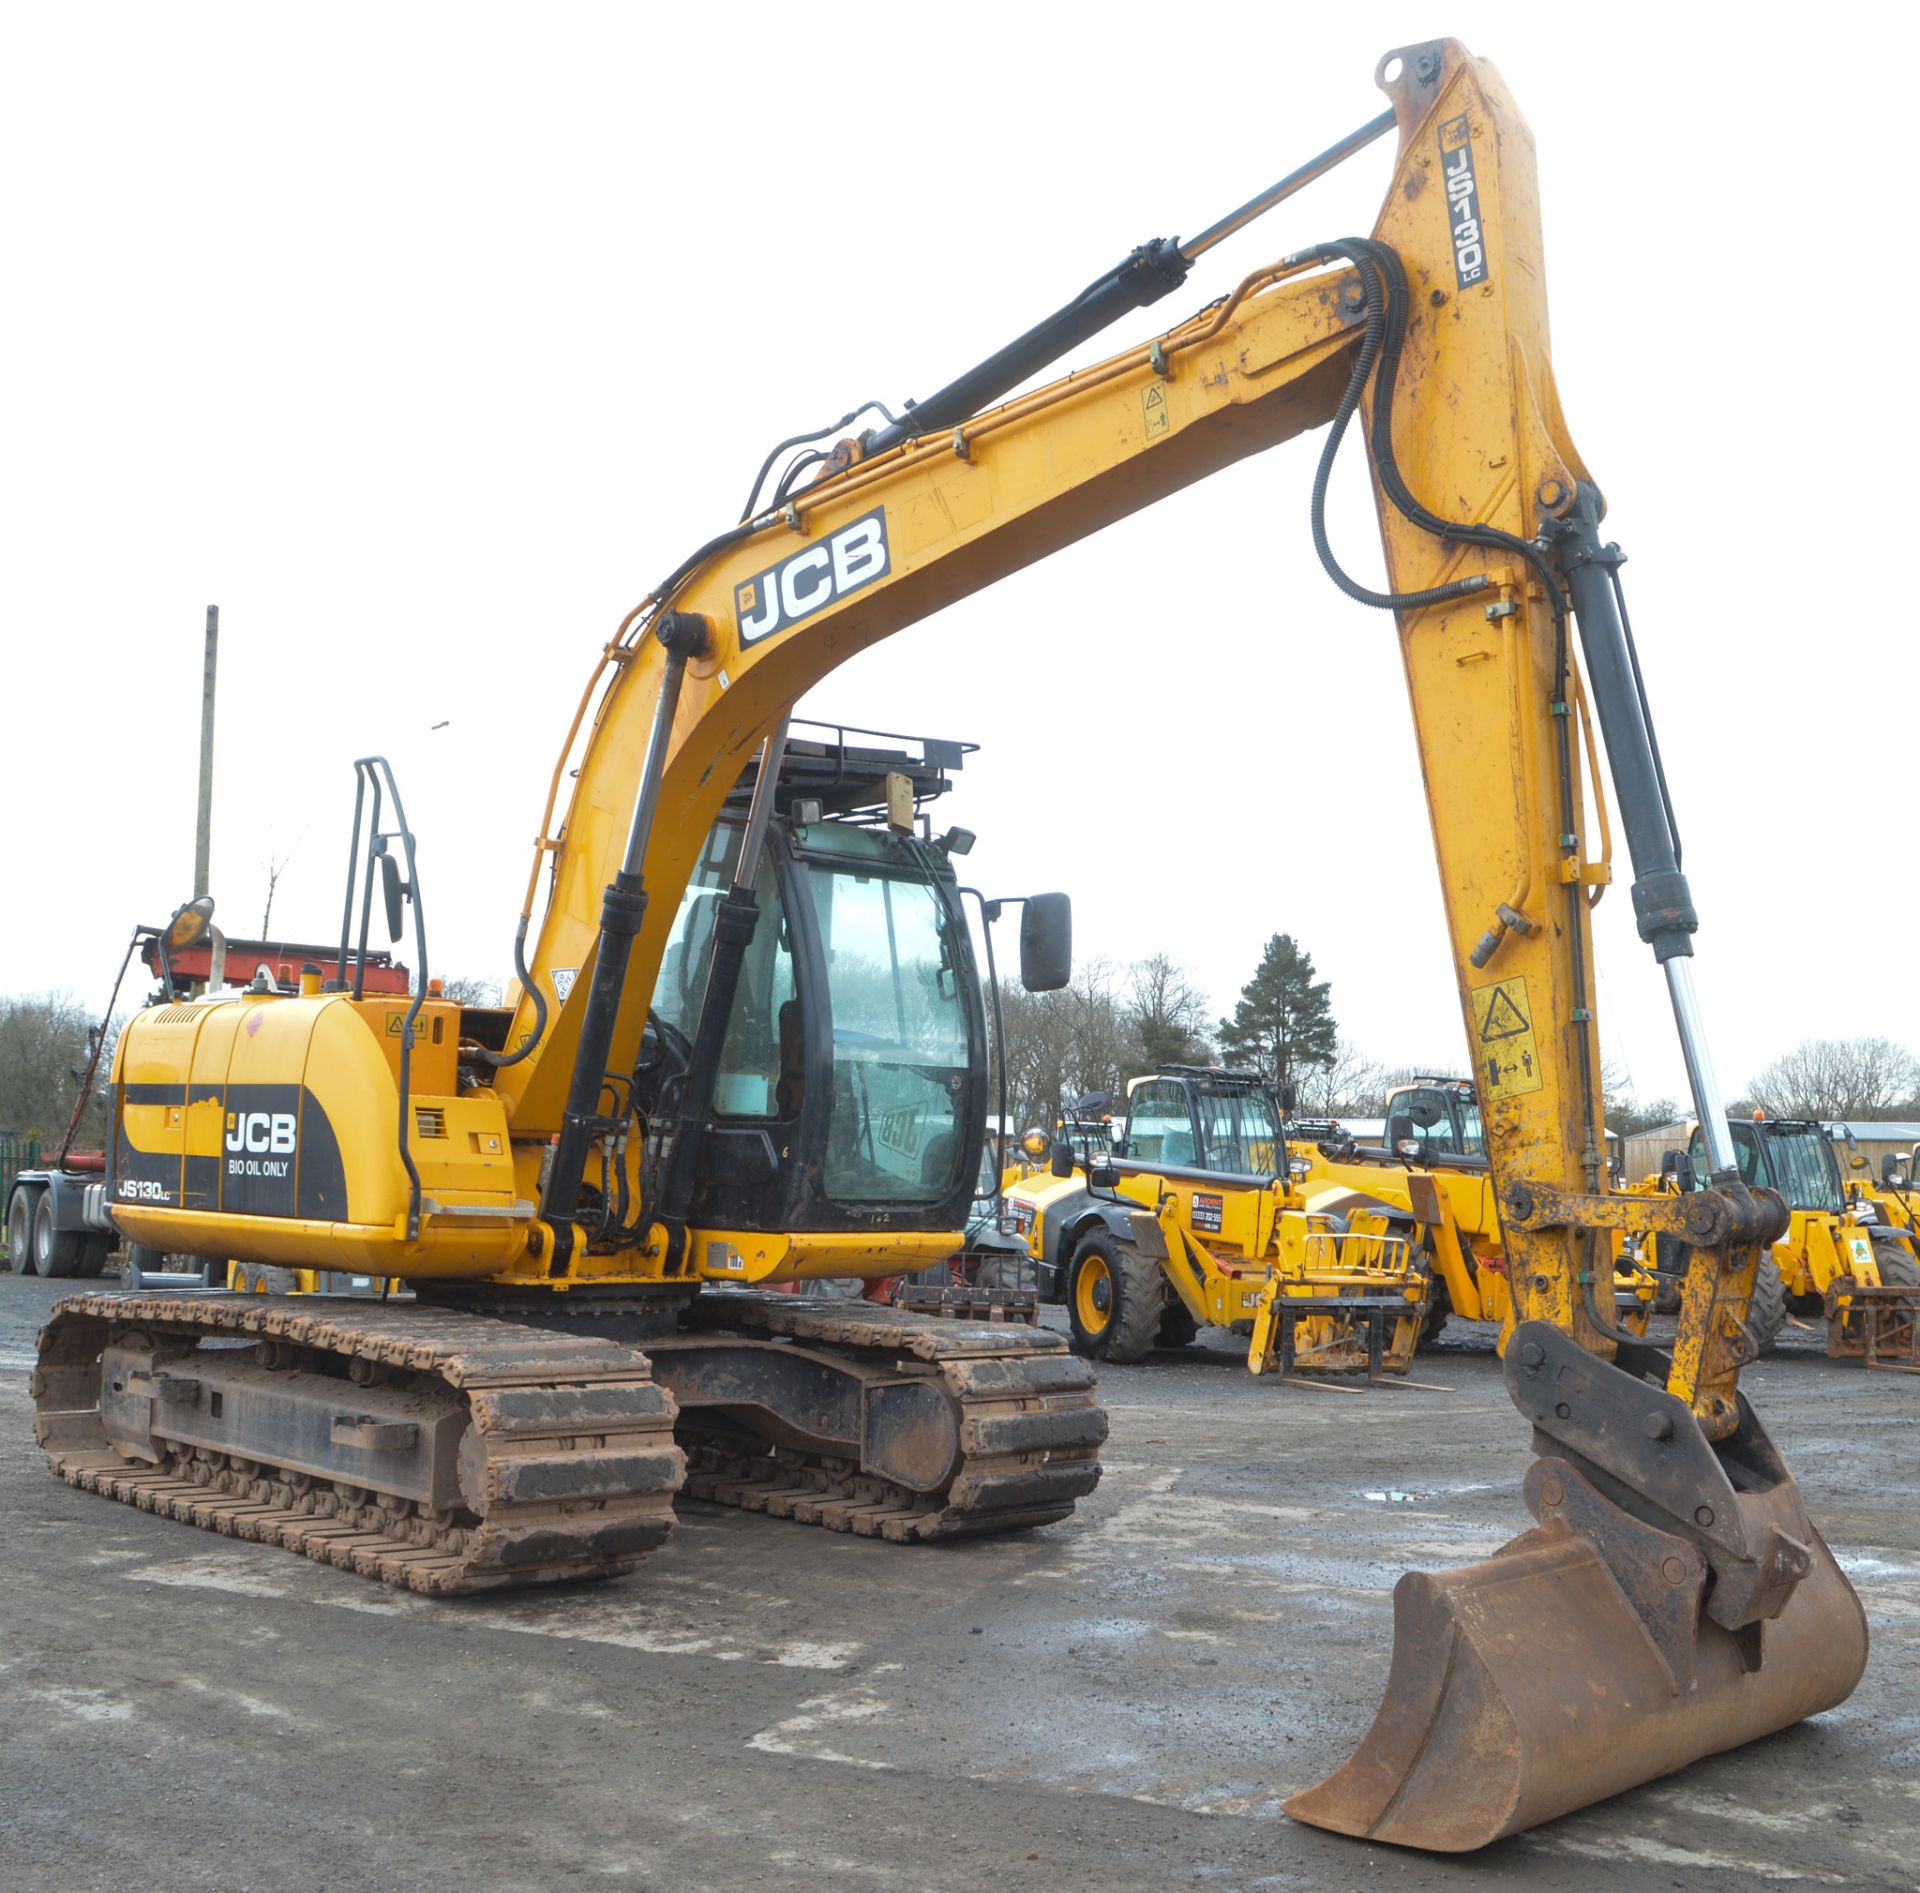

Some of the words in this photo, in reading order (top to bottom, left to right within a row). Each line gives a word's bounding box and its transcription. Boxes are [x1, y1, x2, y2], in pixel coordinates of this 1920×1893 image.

[741, 518, 886, 641] JCB
[226, 1112, 297, 1154] JCB
[228, 1159, 245, 1175] BIO
[246, 1160, 262, 1176] OIL
[262, 1161, 289, 1177] ONLY
